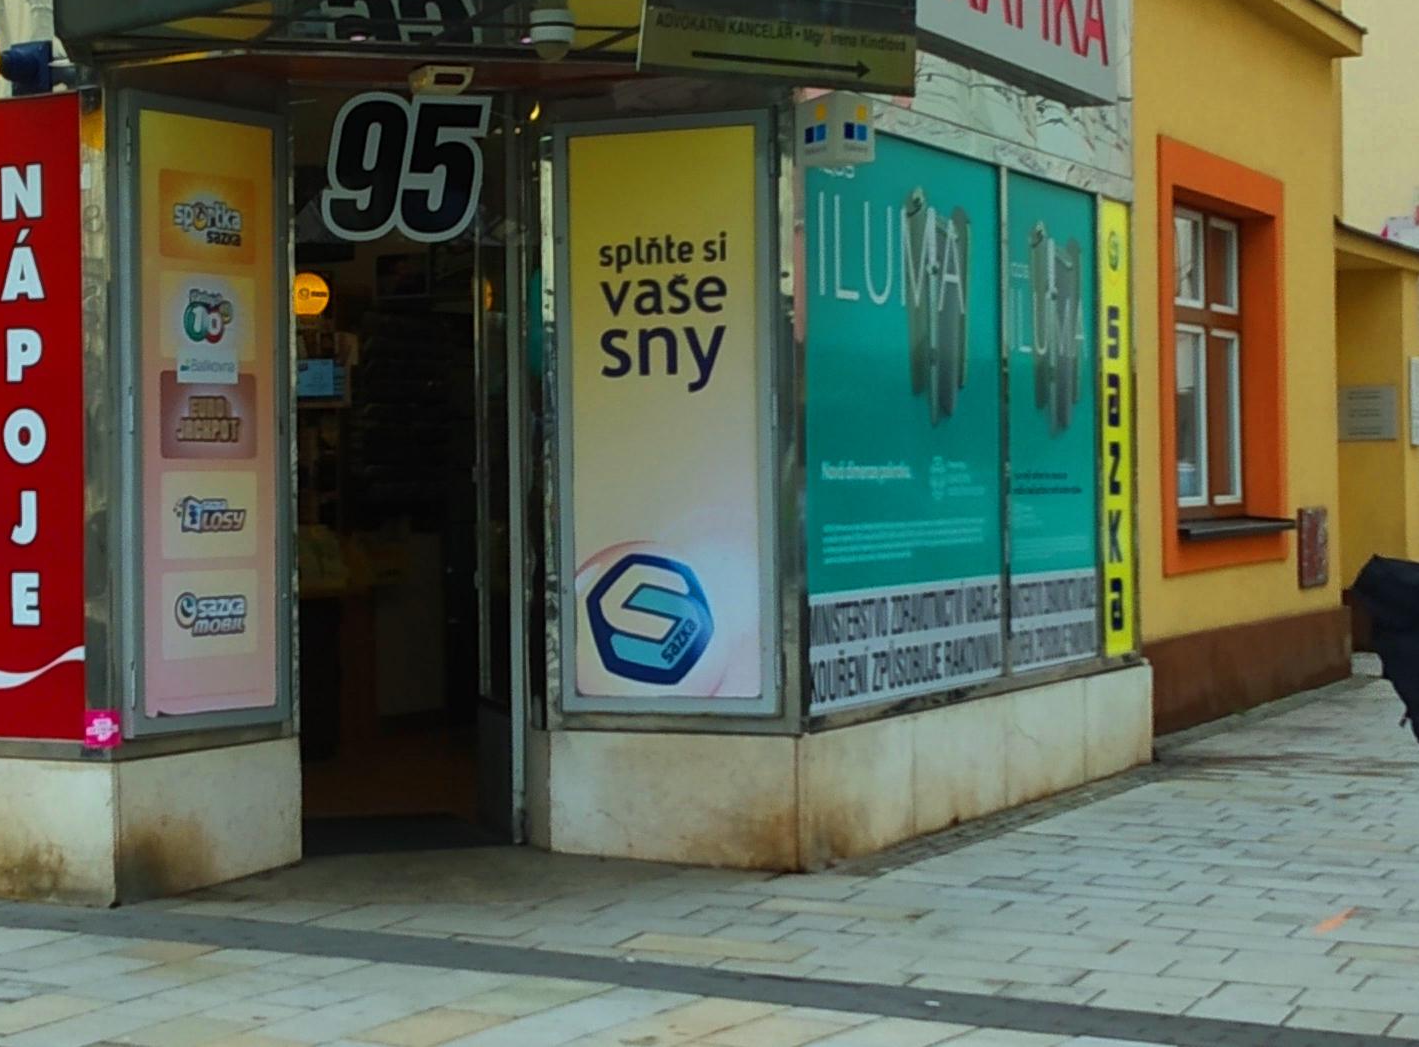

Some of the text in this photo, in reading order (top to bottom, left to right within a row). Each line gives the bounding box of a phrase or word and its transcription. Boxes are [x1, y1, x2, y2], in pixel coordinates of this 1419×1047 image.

[322, 92, 493, 243] 95
[600, 231, 727, 274] splňte si
[818, 191, 966, 316] ILUMA
[600, 274, 727, 317] vaše
[600, 325, 727, 393] sny
[0, 163, 47, 627] NÁPOJE
[201, 509, 245, 530] LOSY
[660, 619, 698, 664] sazka
